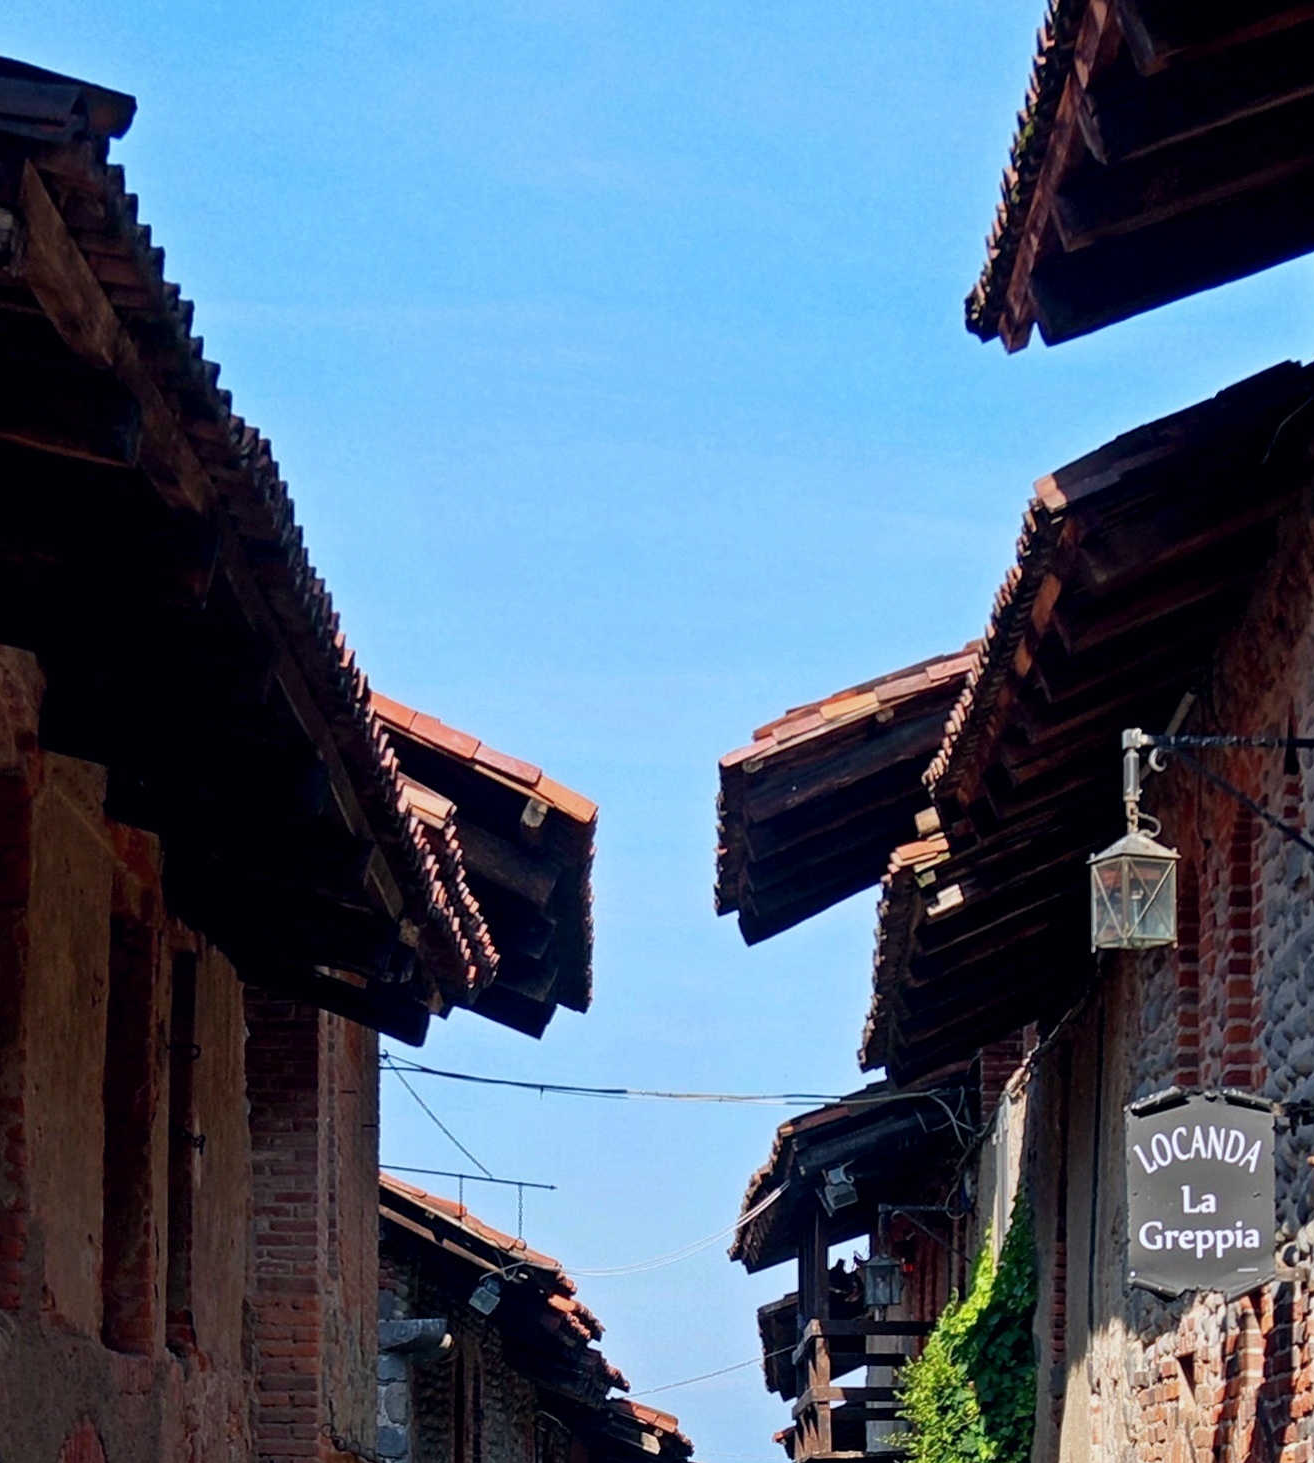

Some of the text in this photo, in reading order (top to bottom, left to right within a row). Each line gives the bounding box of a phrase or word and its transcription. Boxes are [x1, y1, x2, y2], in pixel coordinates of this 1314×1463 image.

[1133, 1125, 1262, 1174] LOCANDA
[1181, 1185, 1217, 1214] La
[1139, 1221, 1261, 1259] Greppia
